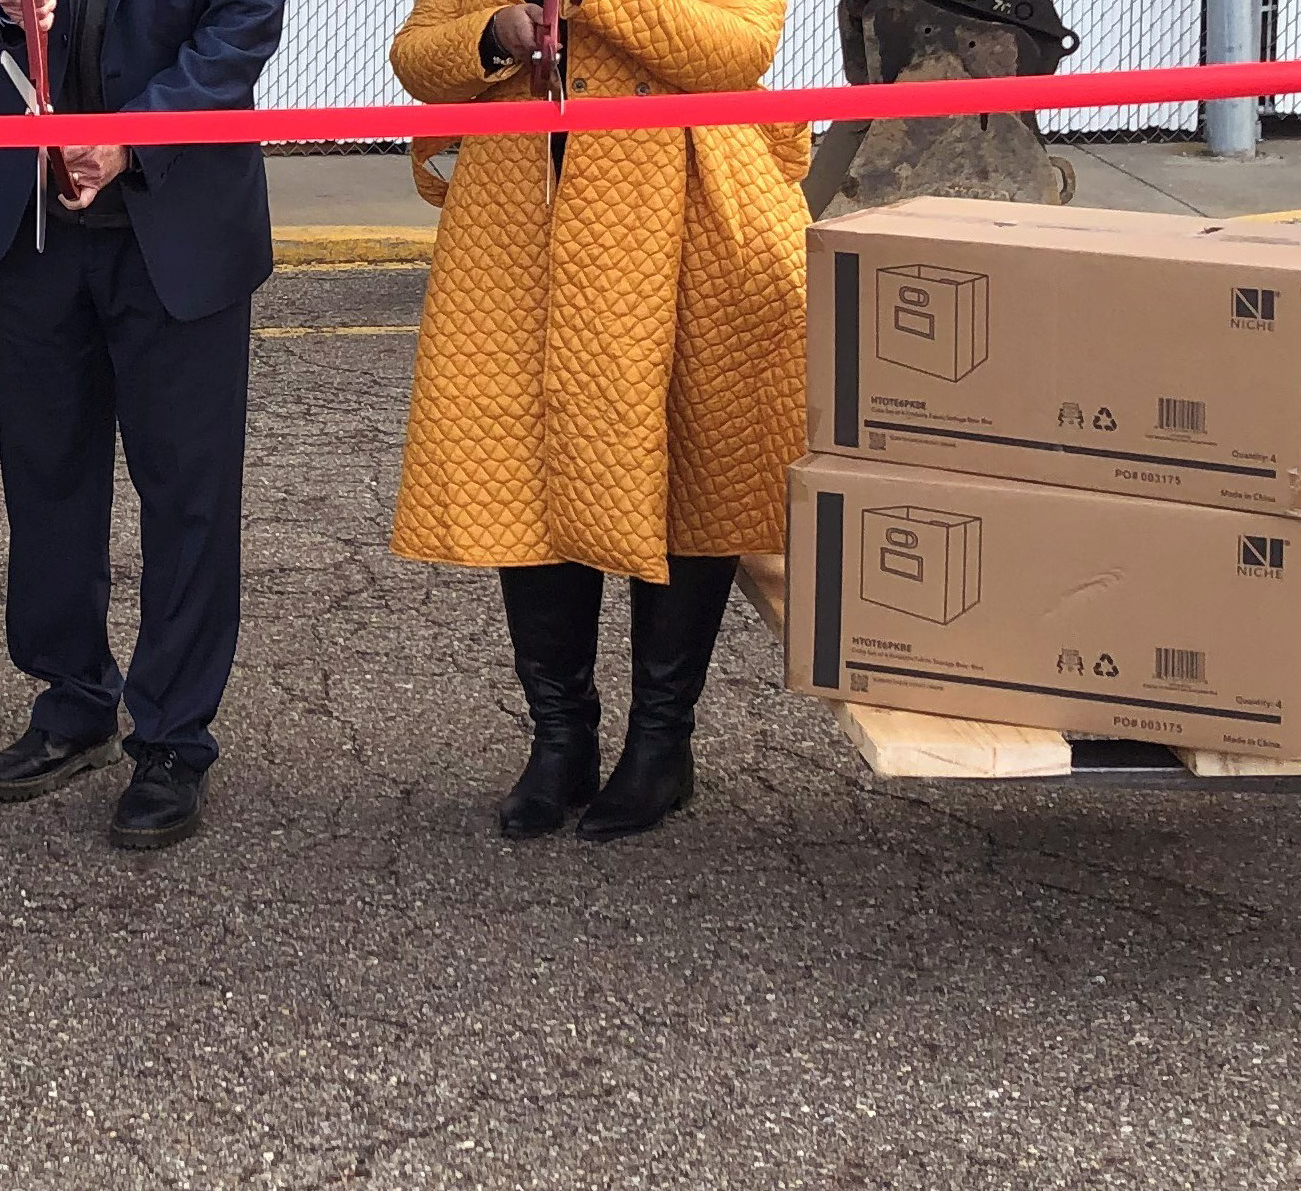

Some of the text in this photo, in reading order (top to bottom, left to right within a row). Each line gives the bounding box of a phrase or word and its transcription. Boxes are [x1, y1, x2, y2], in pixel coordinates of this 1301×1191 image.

[1230, 318, 1275, 332] NICHE
[1140, 471, 1182, 487] 003175
[1236, 566, 1283, 579] NICHE
[1140, 718, 1183, 734] 003175
